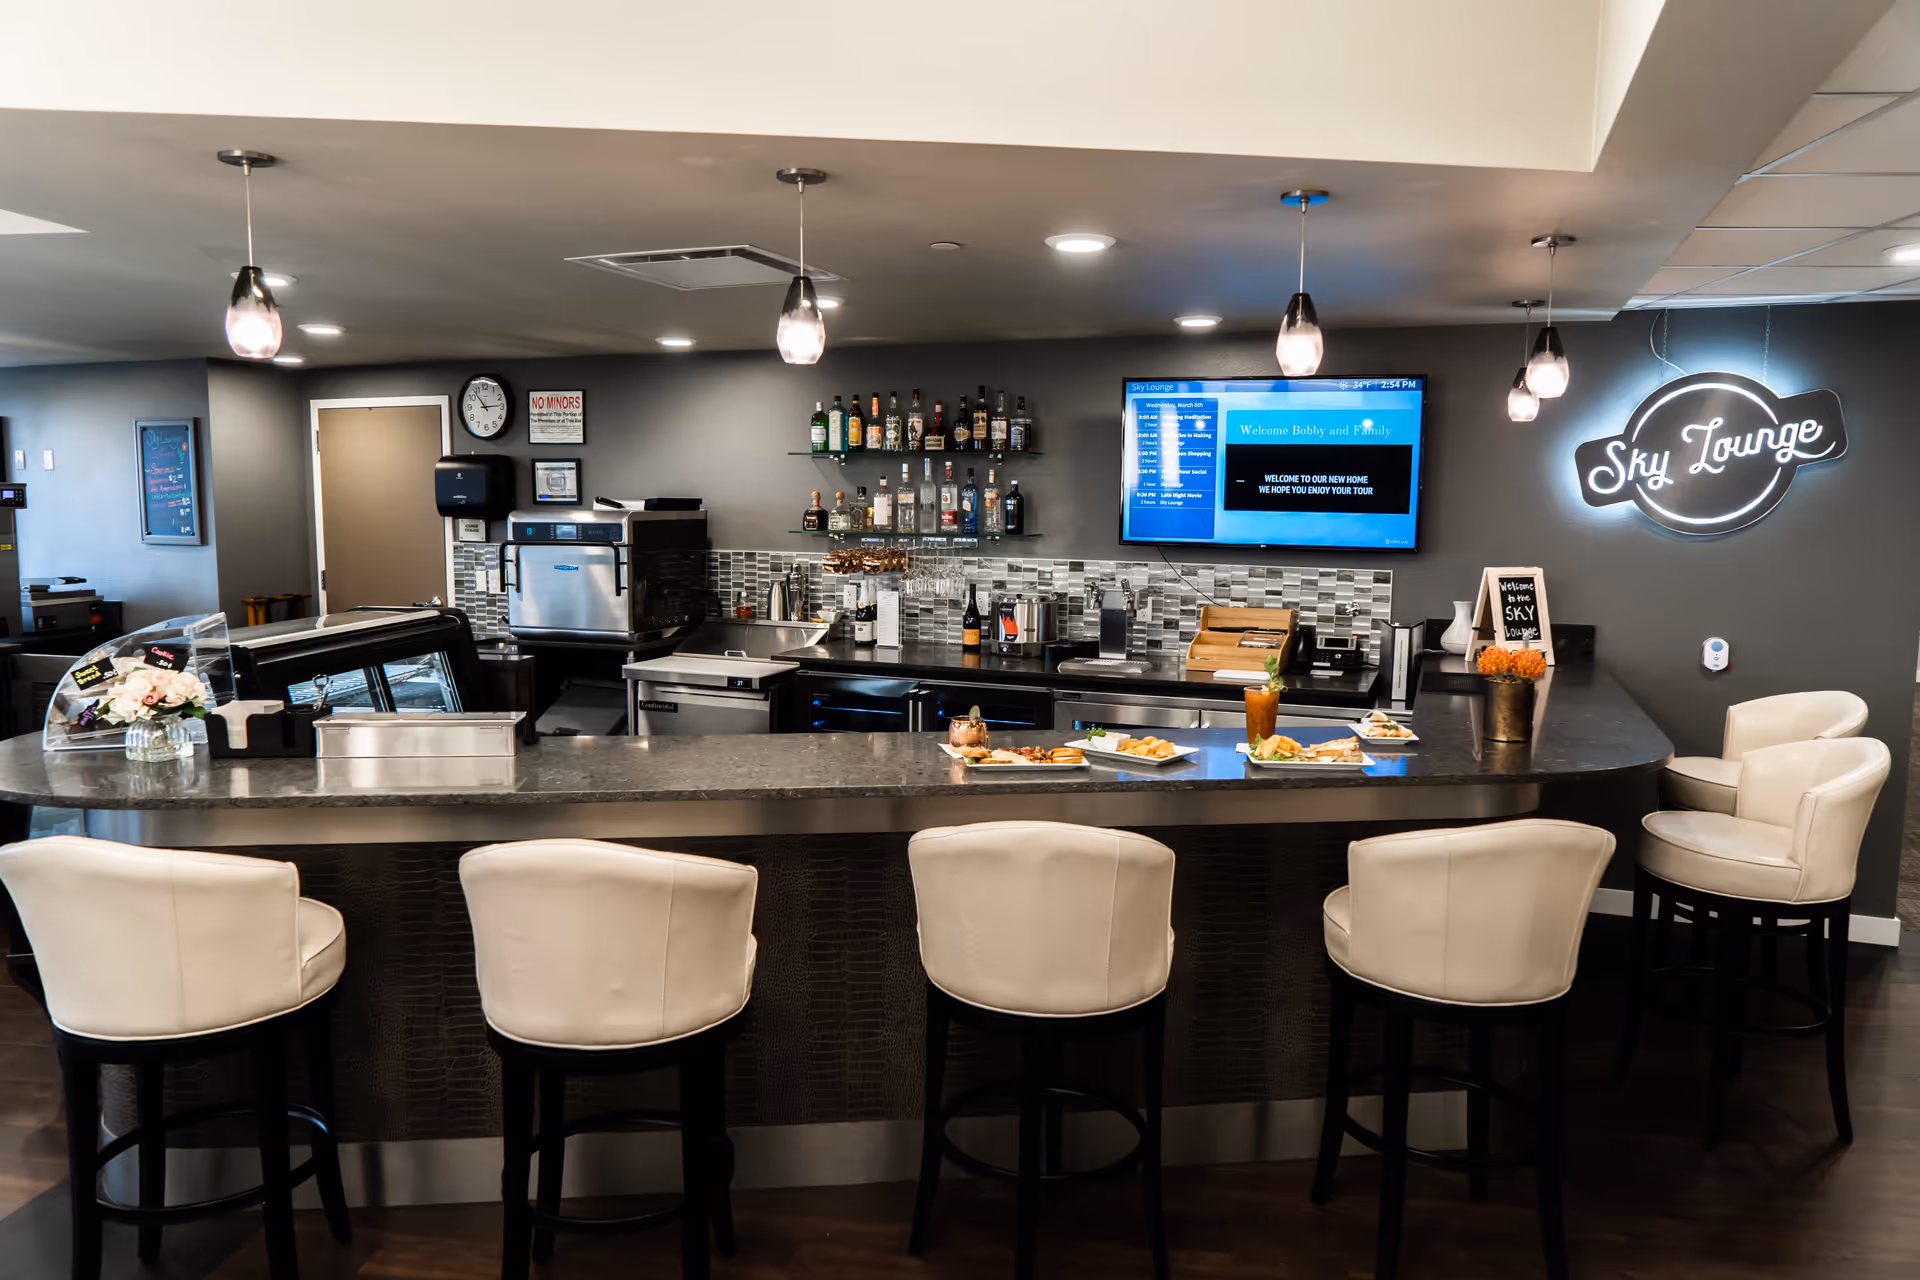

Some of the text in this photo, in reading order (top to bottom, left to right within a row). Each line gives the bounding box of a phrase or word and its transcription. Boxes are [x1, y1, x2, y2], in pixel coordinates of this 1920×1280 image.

[1132, 384, 1173, 392] Sky Lounge
[532, 396, 581, 409] NO MINORS
[1240, 425, 1391, 438] Welcome Bobby and Family
[1588, 417, 1836, 494] Sky Lounge
[1265, 475, 1368, 484] WELCOME TO OUR NEW HOME
[1259, 486, 1373, 495] WE HOPE YOU ENJOY YOUR TOUR
[1499, 582, 1534, 591] Welcome
[1507, 594, 1531, 603] to the
[1505, 605, 1534, 621] SKY
[1504, 625, 1538, 639] Lounge
[151, 647, 175, 660] Cookie
[74, 665, 99, 679] Sweet
